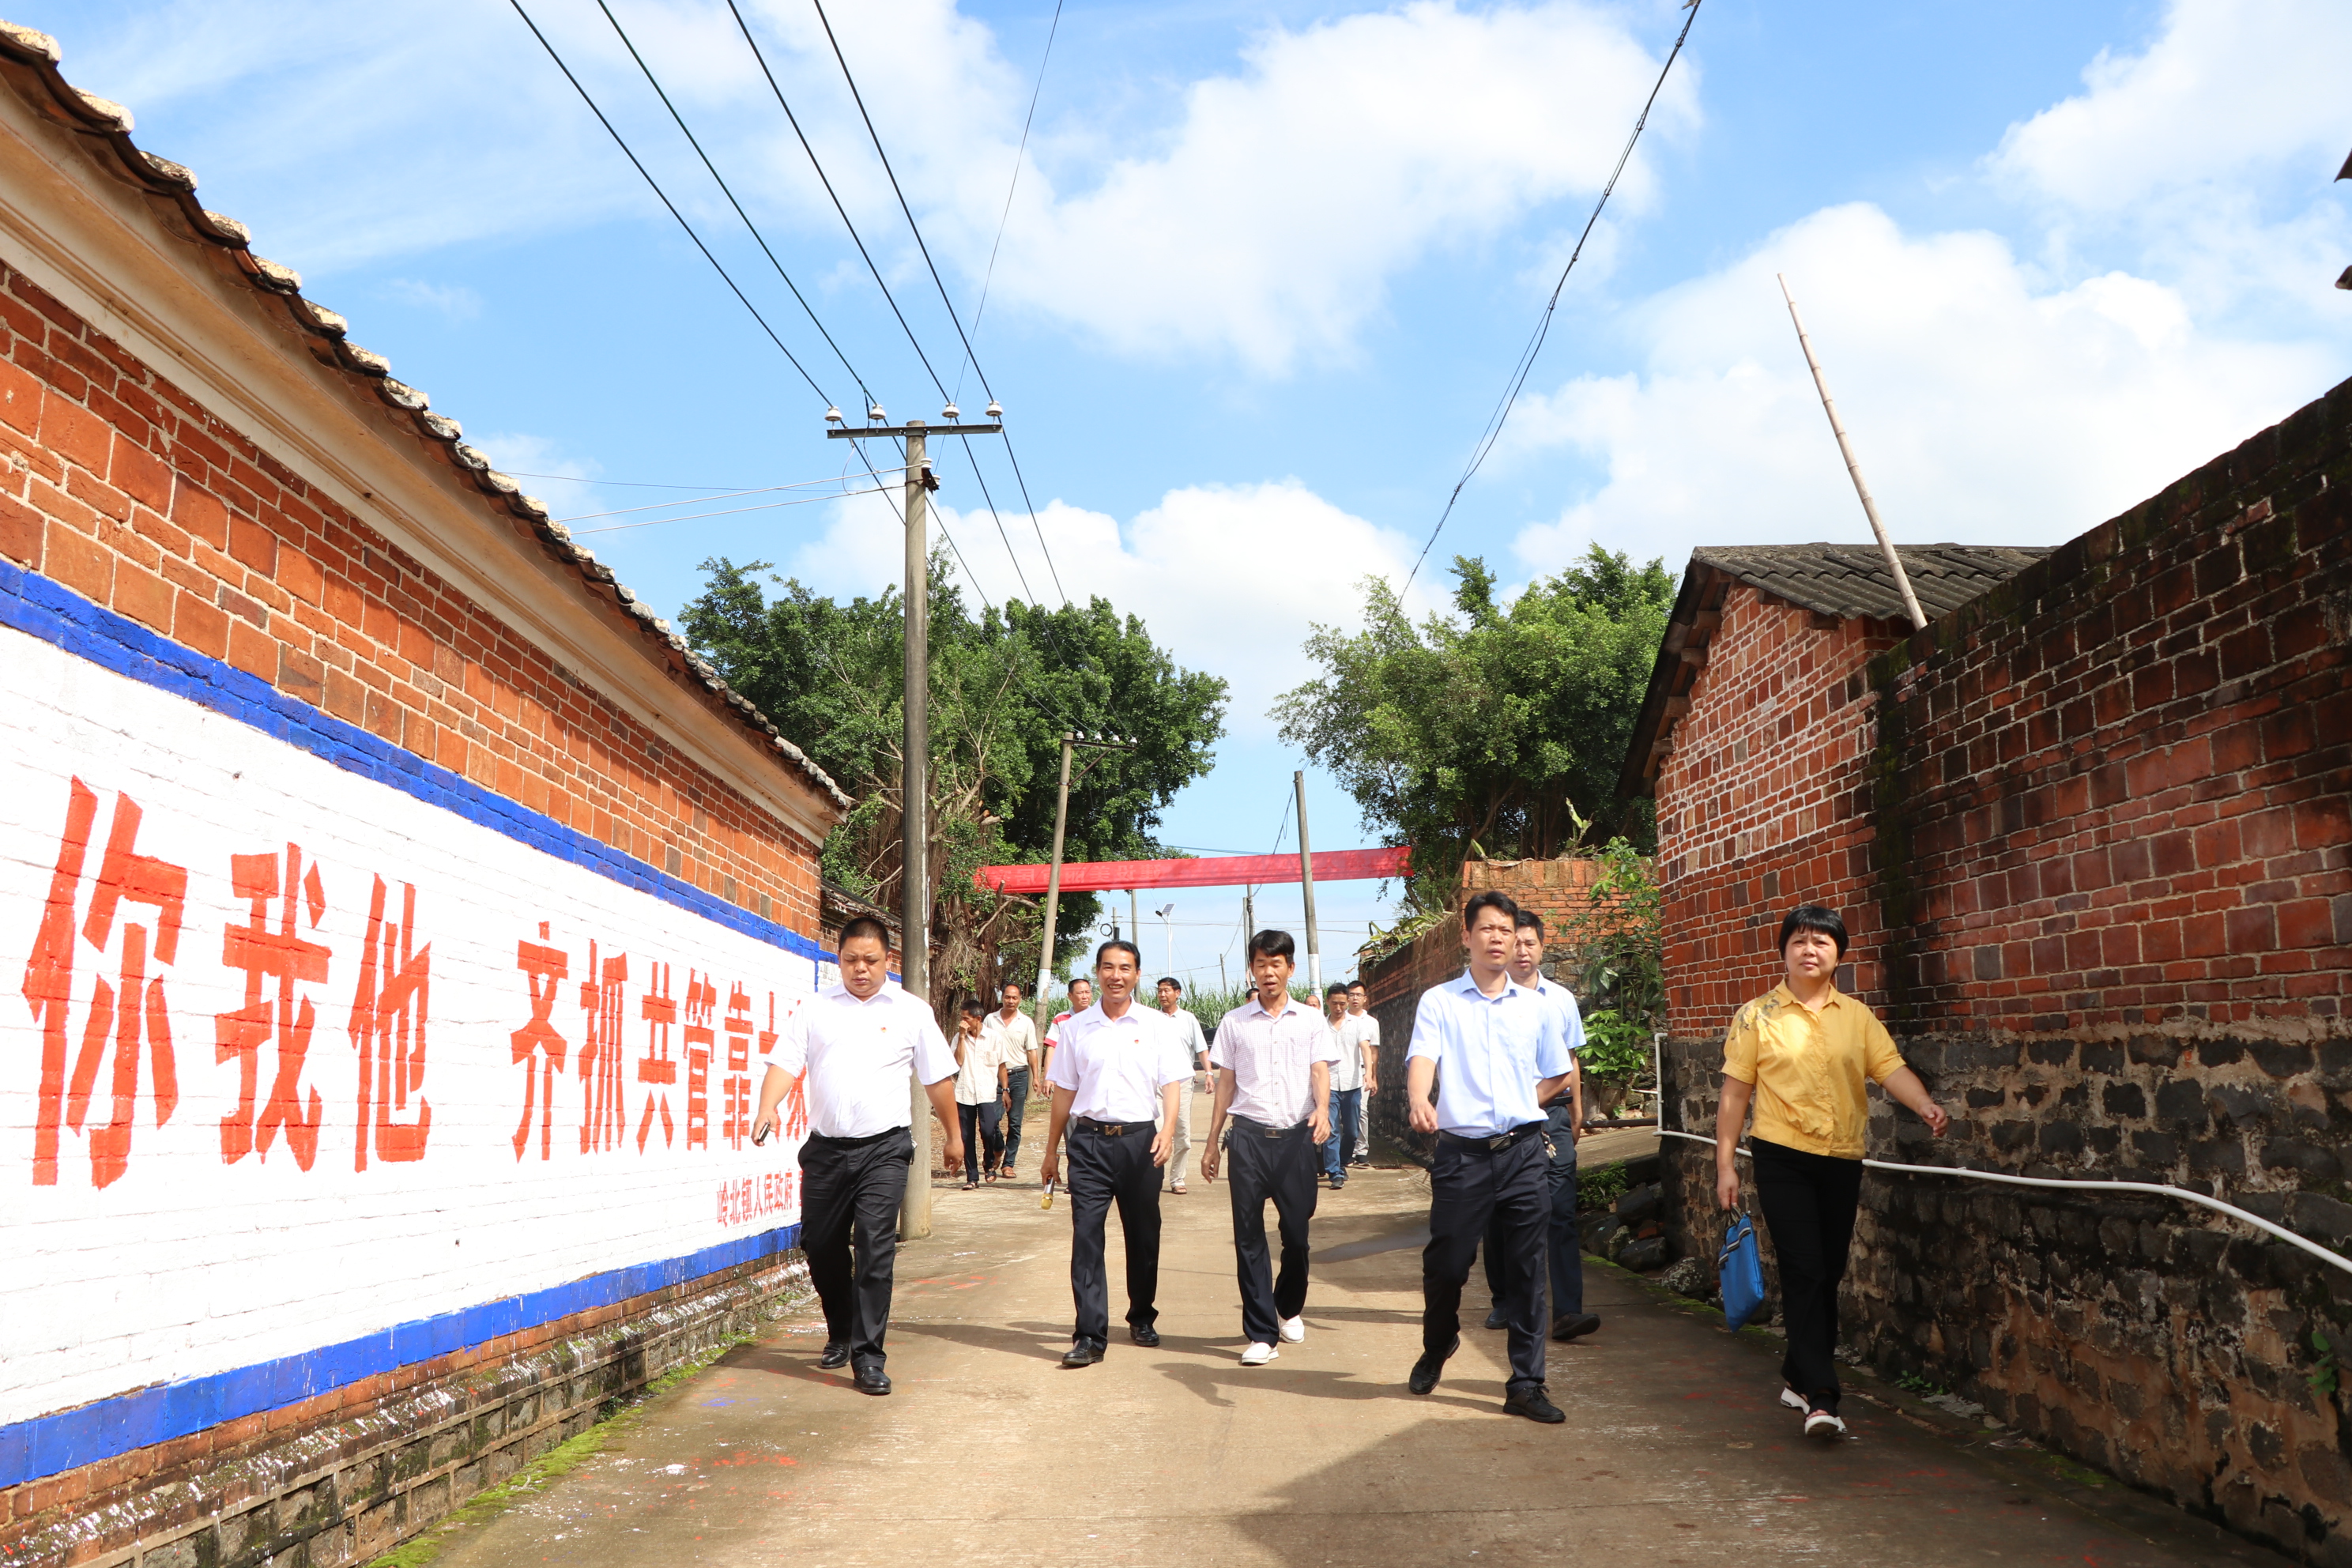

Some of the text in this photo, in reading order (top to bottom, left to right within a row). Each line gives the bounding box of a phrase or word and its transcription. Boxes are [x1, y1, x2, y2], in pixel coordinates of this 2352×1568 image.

[21, 775, 432, 1191] 你我他
[716, 1168, 793, 1227] 岭北镇人民政府
